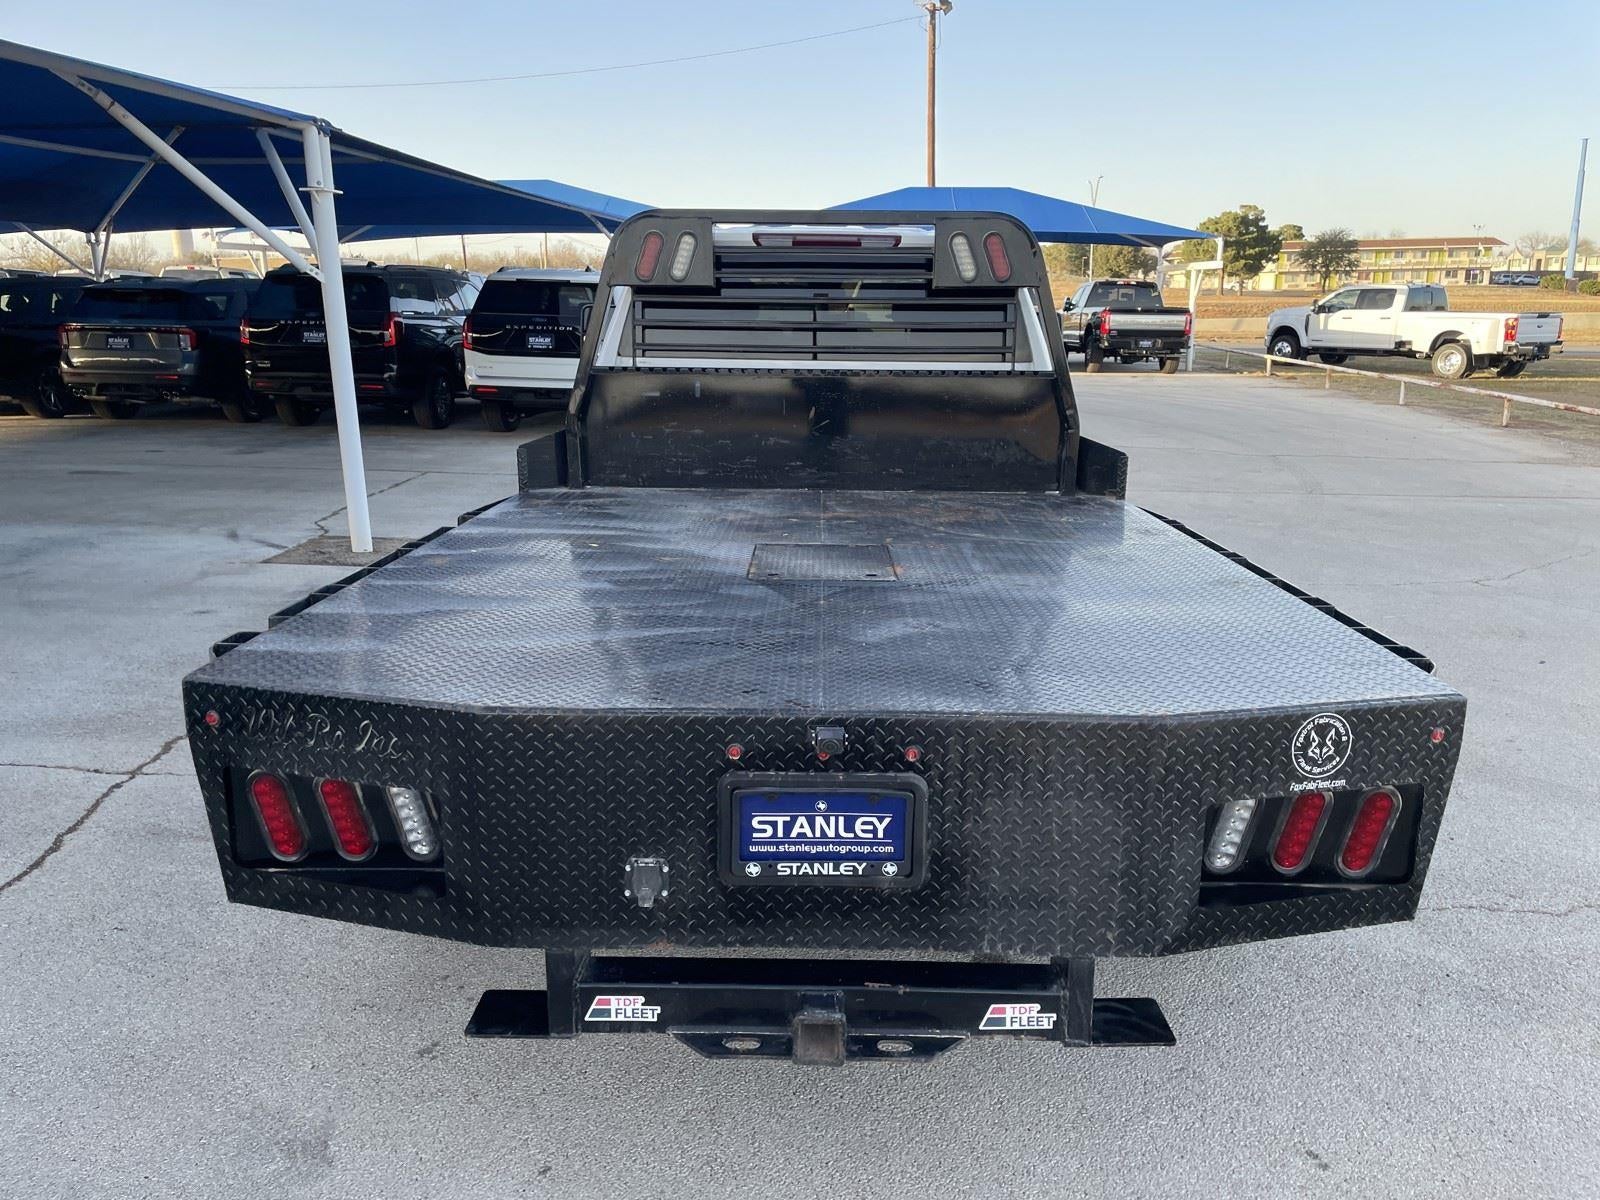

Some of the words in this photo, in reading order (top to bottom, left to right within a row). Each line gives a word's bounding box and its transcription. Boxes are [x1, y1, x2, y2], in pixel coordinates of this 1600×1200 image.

[1289, 779, 1346, 792] FoxFabFleet.com
[751, 815, 892, 839] STANLEY
[749, 843, 895, 855] www.stanleyautogroup.com
[776, 862, 867, 876] STANLEY
[614, 997, 640, 1007] TDF
[614, 1007, 658, 1020] FLEET
[1009, 1005, 1035, 1015] TDF
[1009, 1015, 1055, 1028] FLEET
